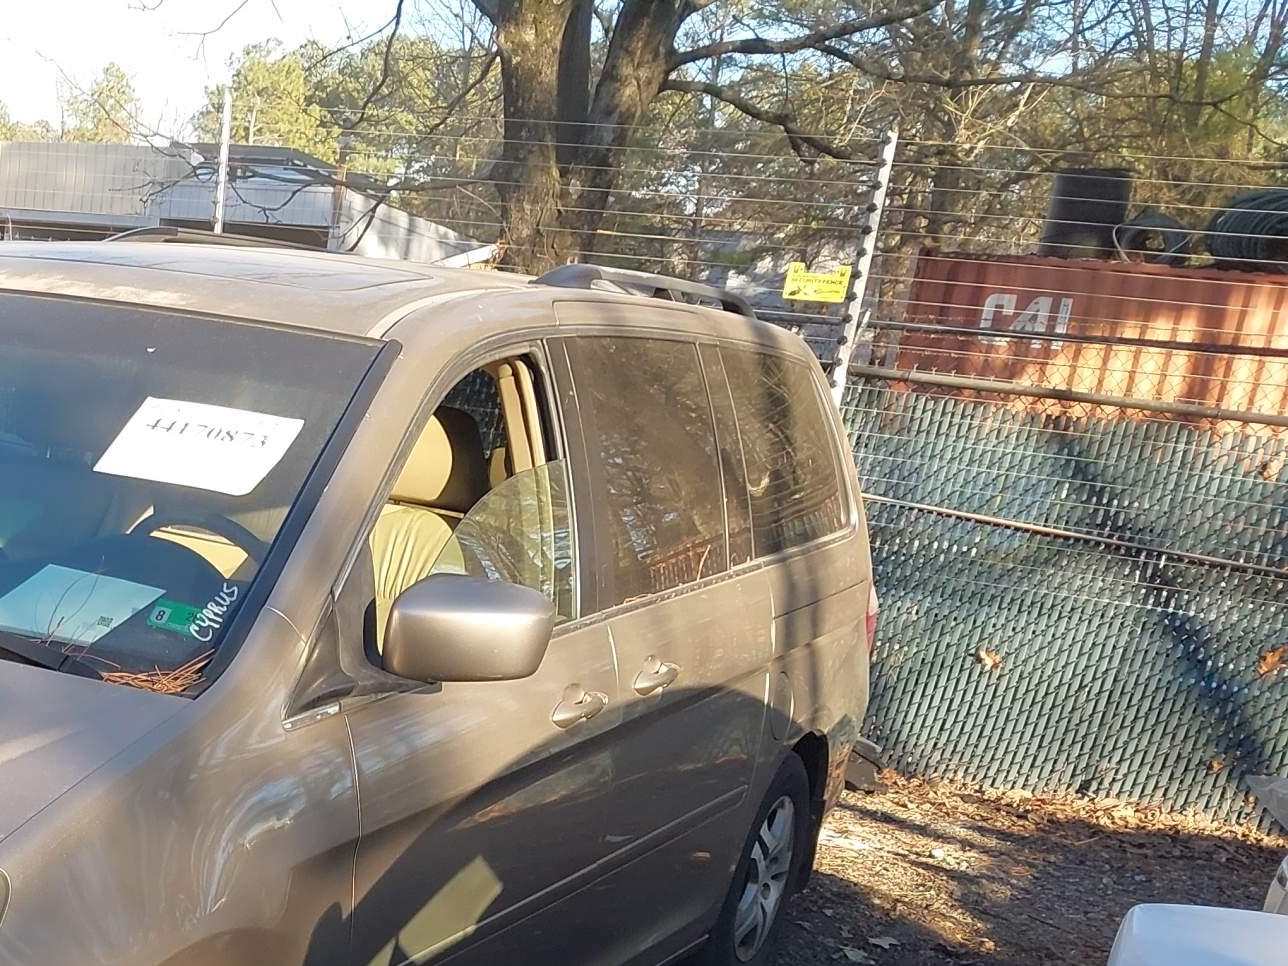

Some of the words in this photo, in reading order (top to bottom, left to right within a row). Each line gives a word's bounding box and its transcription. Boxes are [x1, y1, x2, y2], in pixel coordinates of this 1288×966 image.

[145, 418, 268, 447] 44170873
[155, 610, 166, 621] 8
[189, 582, 238, 641] CYPRUS
